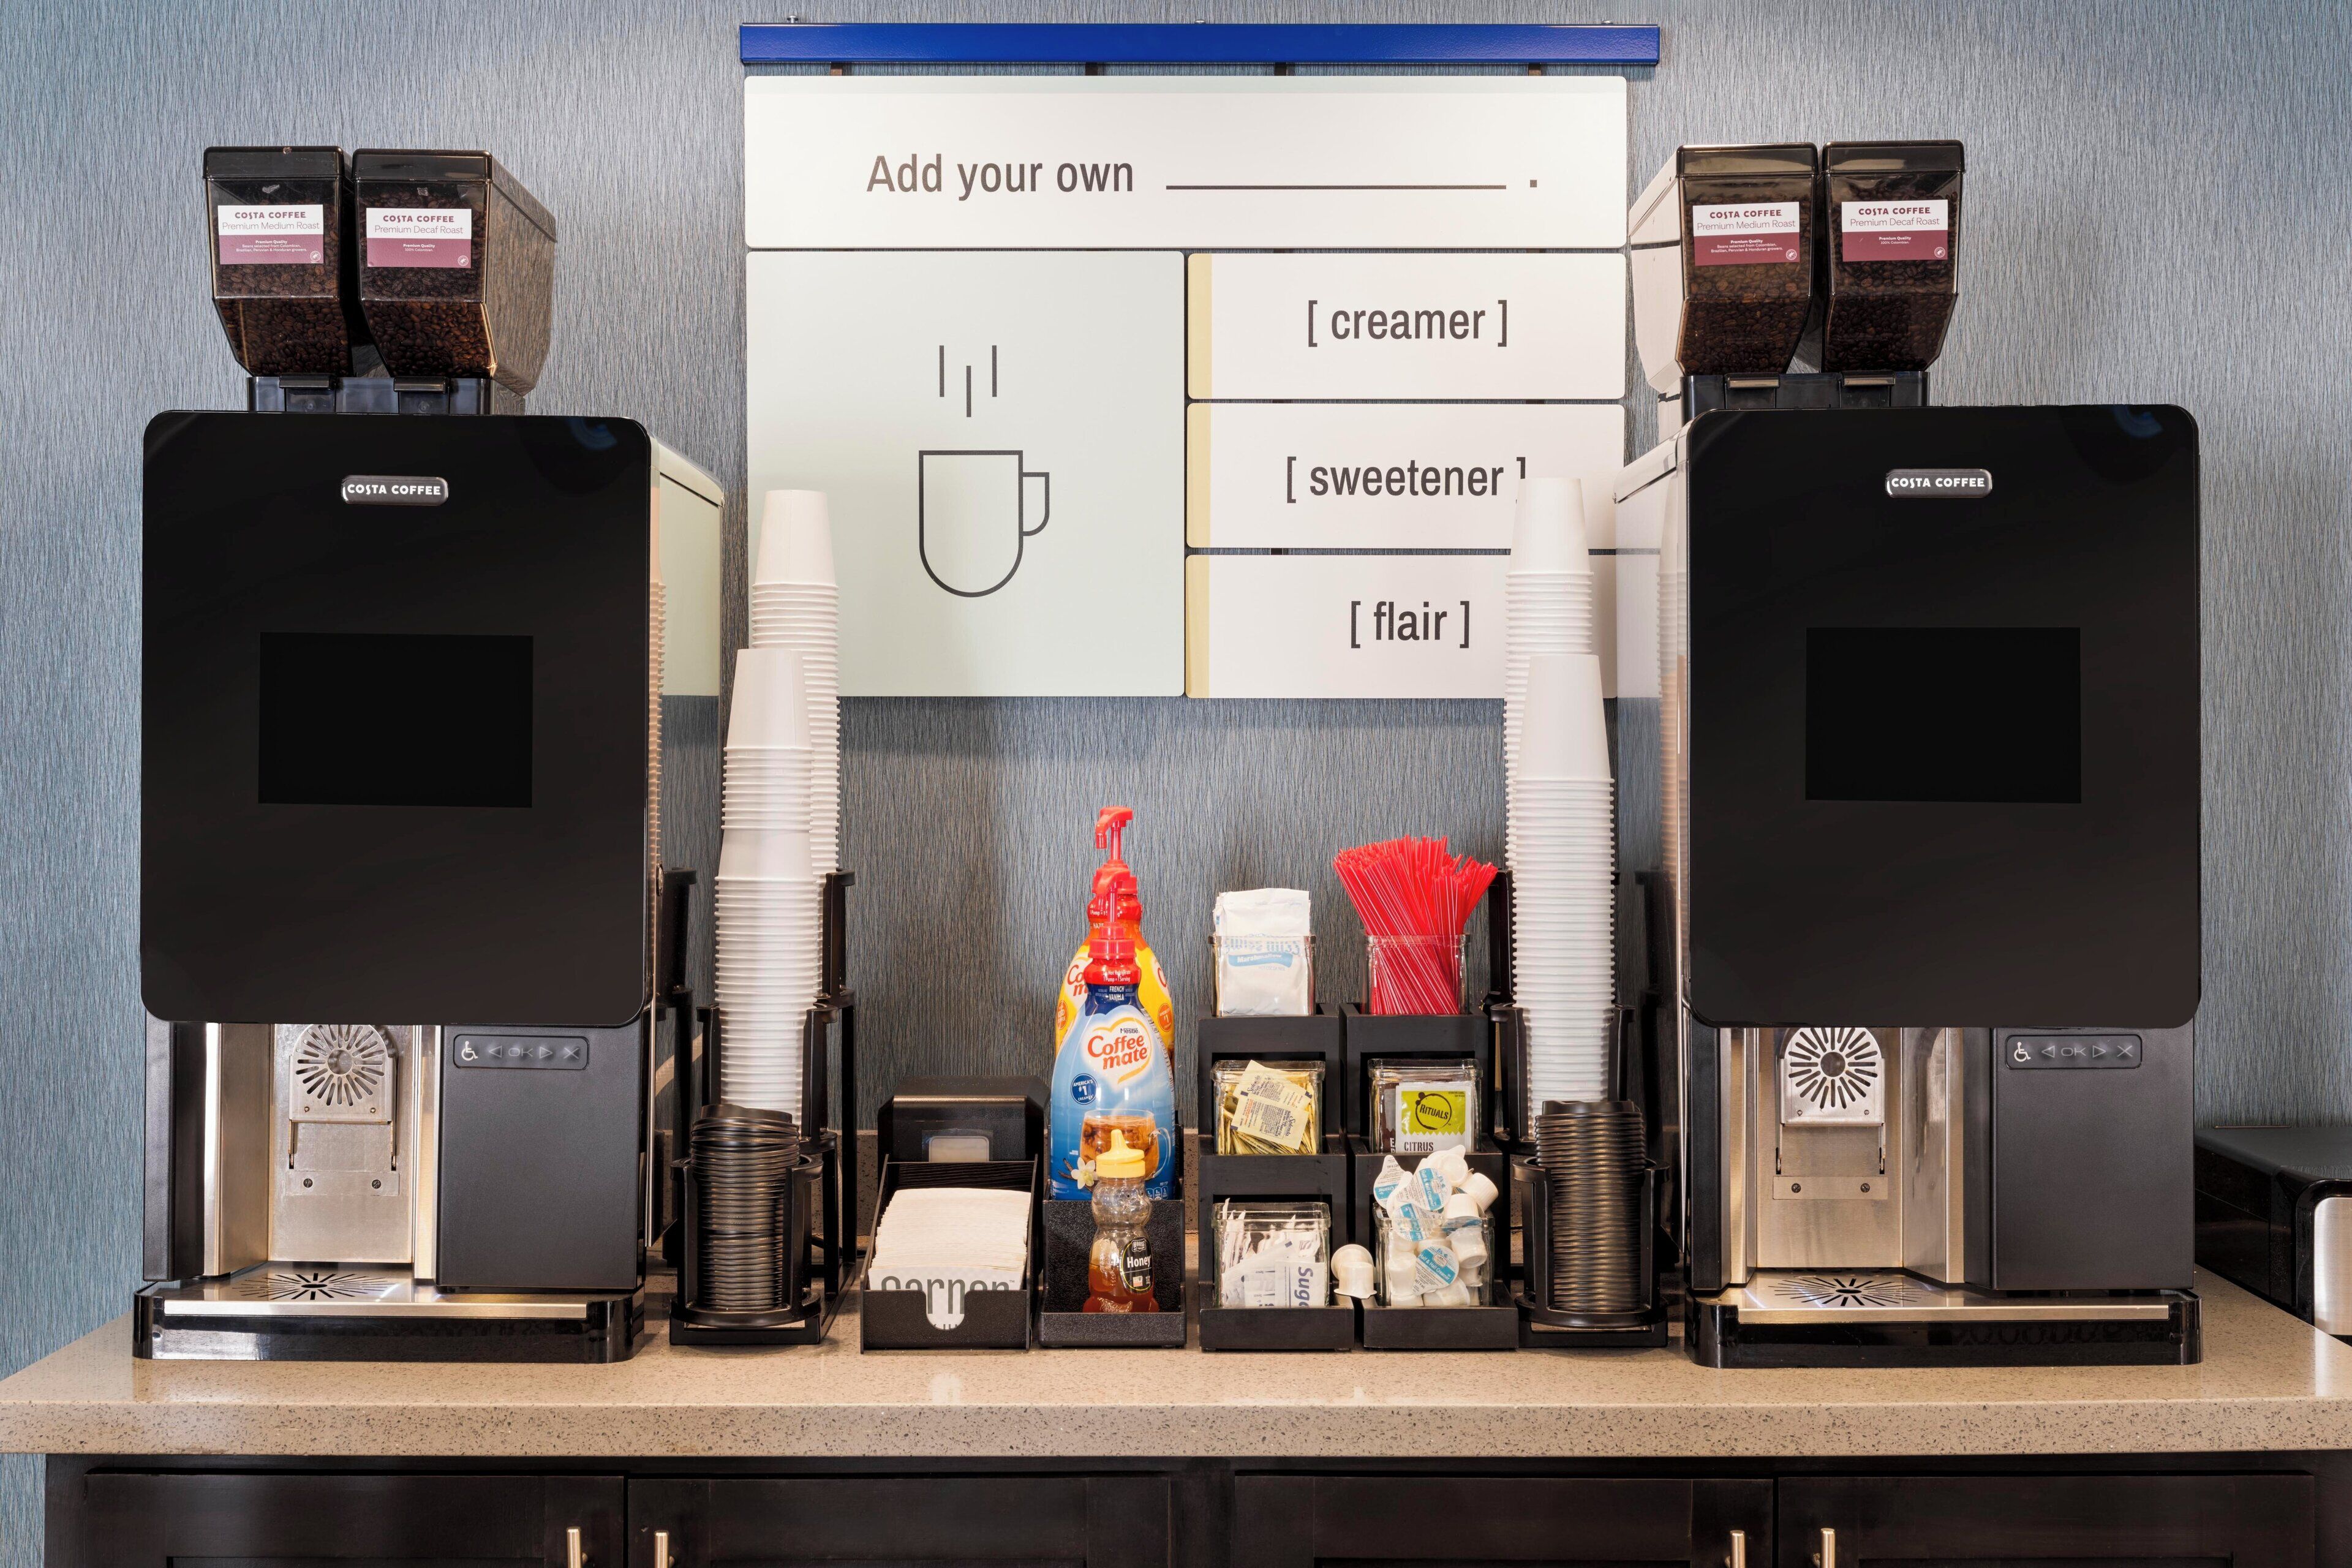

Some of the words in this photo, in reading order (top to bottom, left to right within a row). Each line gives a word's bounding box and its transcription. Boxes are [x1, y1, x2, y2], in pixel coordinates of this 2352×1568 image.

[866, 154, 942, 192] Add
[957, 163, 1042, 201] your
[1057, 163, 1133, 192] own
[1891, 478, 1931, 488] COSTA
[1936, 478, 1985, 487] COFFEE
[347, 484, 386, 495] COSTA
[391, 485, 441, 495] COFFEE
[1237, 954, 1281, 963] Marshmallow
[1088, 1035, 1144, 1057] Coffee
[2061, 1047, 2086, 1056] OK
[508, 1048, 533, 1057] OK
[1102, 1046, 1148, 1069] mate
[1420, 1104, 1449, 1120] RITUALS
[1285, 1116, 1296, 1137] Splenda
[1404, 1142, 1433, 1152] CITRUS
[1127, 1256, 1150, 1268] Honey
